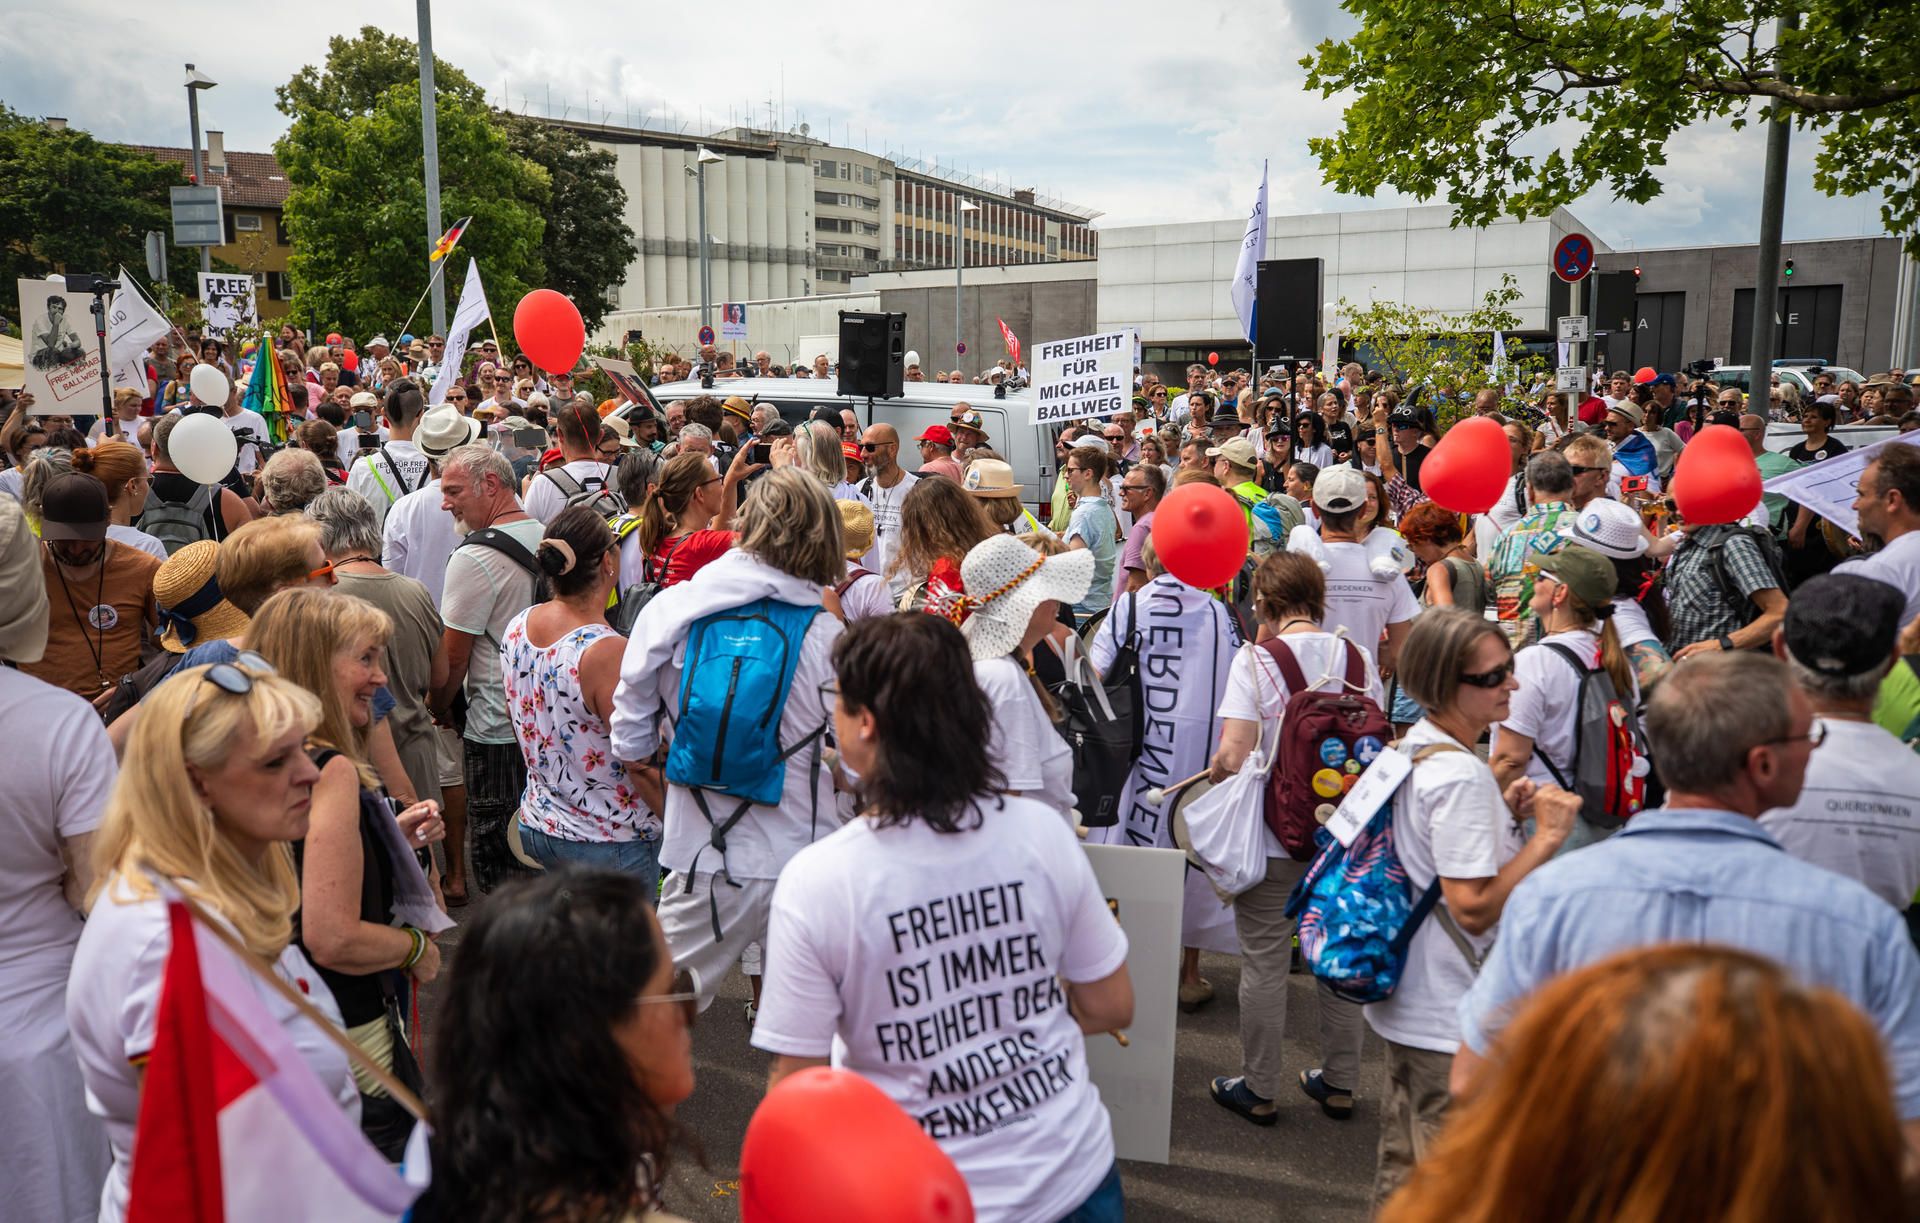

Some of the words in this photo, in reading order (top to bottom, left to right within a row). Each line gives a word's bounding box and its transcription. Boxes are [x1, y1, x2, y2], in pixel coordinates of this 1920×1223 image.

[205, 278, 247, 294] FREE
[1638, 318, 1648, 329] A
[1042, 334, 1124, 360] FREIHEIT
[50, 370, 70, 387] FREE
[1062, 358, 1097, 377] FÜR
[1040, 376, 1120, 400] MICHAEL
[1037, 396, 1122, 421] BALLWEG
[887, 880, 1025, 954] FREIHEIT
[886, 960, 933, 1009] IST
[940, 933, 1047, 993] IMMER
[875, 992, 1004, 1062] FREIHEIT
[1011, 975, 1063, 1022] DER
[913, 1048, 1075, 1140] ENKENDEN
